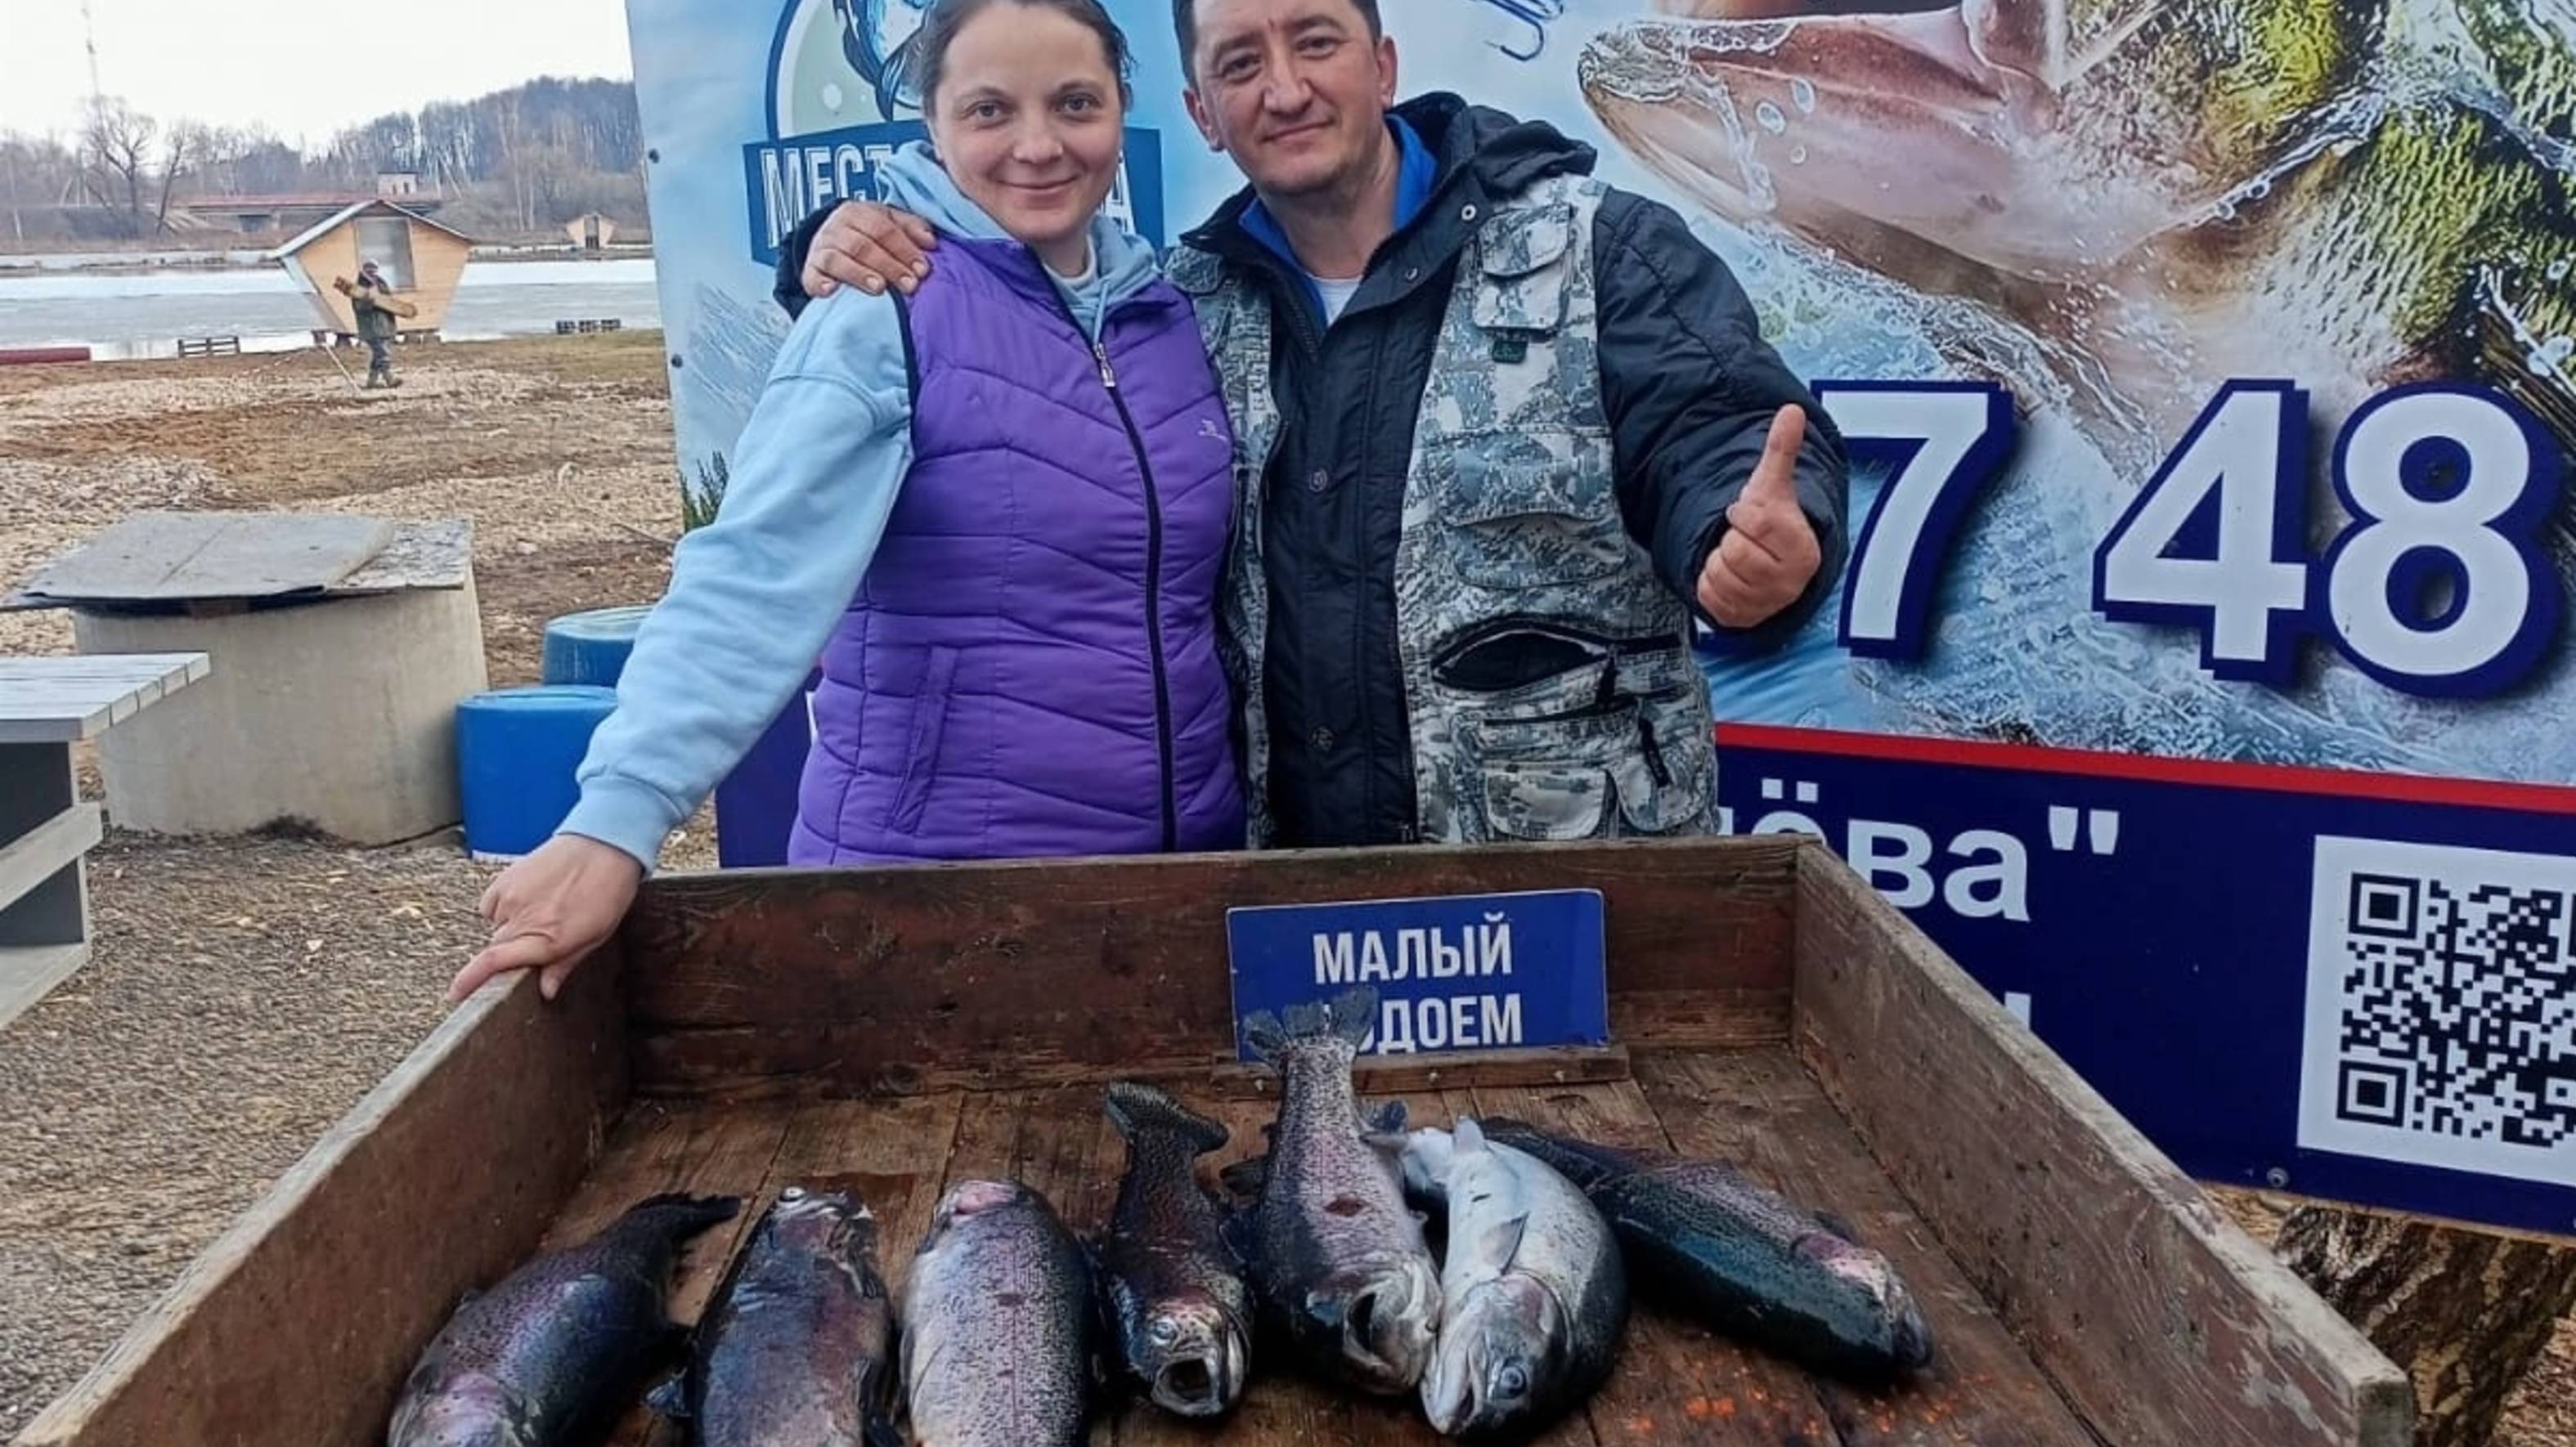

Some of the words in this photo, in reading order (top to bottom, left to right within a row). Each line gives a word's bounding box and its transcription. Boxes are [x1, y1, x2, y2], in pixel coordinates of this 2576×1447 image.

[760, 142, 892, 249] МЕСТ
[2104, 391, 2530, 676] 48
[1313, 911, 1513, 985] МАЛЫЙ
[1323, 992, 1523, 1055] ДОЕМ
